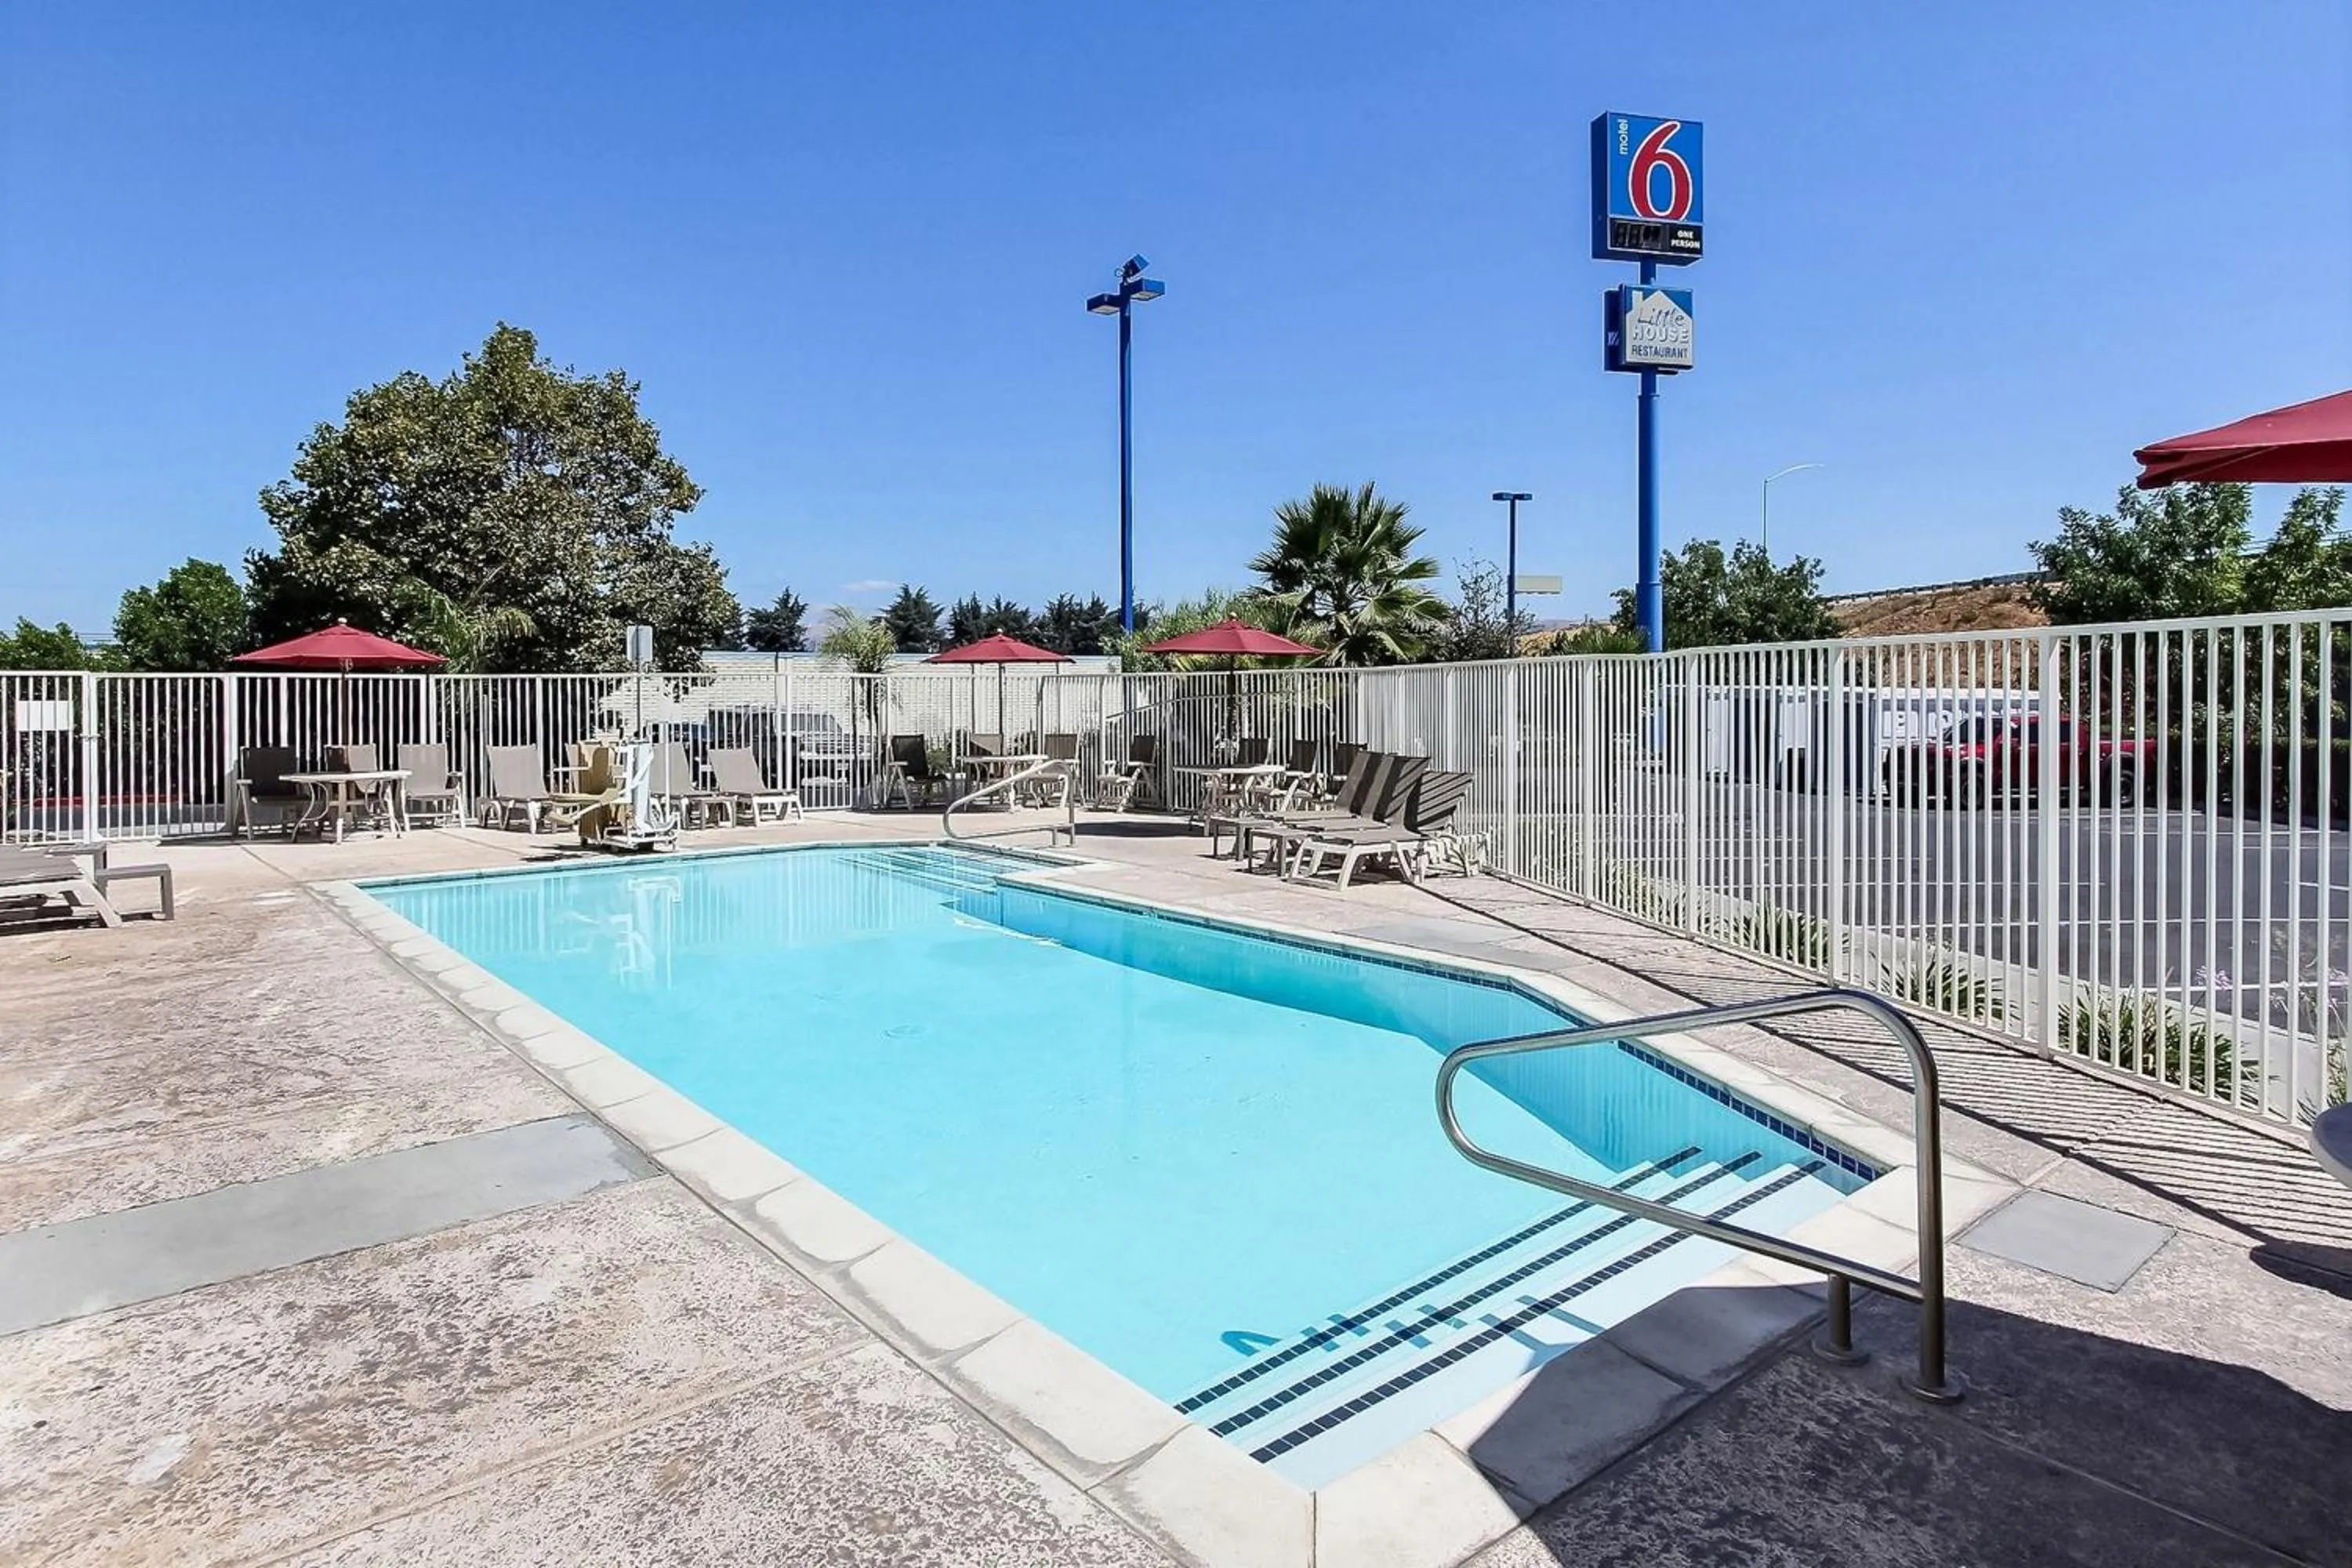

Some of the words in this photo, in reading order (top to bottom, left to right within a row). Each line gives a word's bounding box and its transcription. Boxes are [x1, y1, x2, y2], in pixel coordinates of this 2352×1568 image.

[1617, 119, 1628, 155] motel
[1628, 121, 1693, 220] 6
[1677, 230, 1693, 239] ONE
[1671, 239, 1700, 249] PERSON
[1632, 325, 1689, 343] HOUSE
[1631, 344, 1689, 358] RESTAURANT
